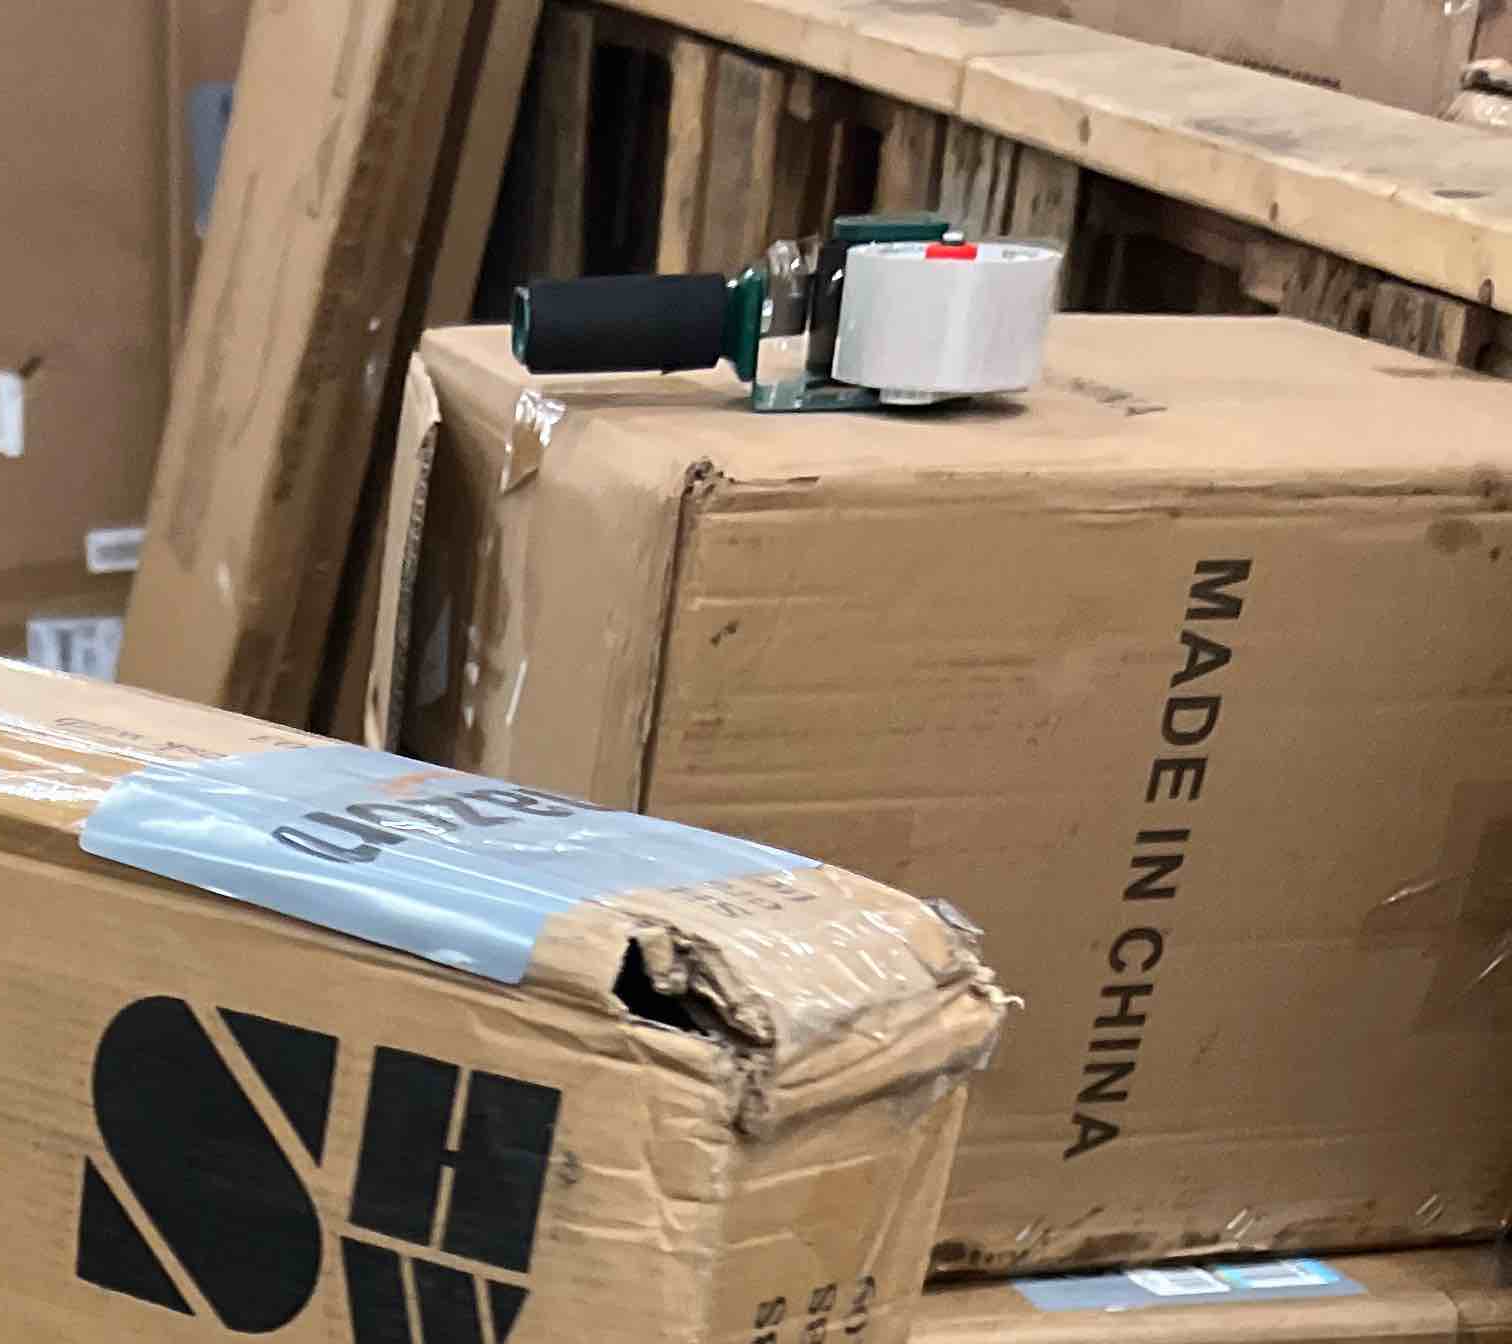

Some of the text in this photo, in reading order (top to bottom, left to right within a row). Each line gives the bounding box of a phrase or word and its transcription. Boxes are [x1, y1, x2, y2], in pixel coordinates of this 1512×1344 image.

[1063, 558, 1253, 1160] MADE IN CHINA
